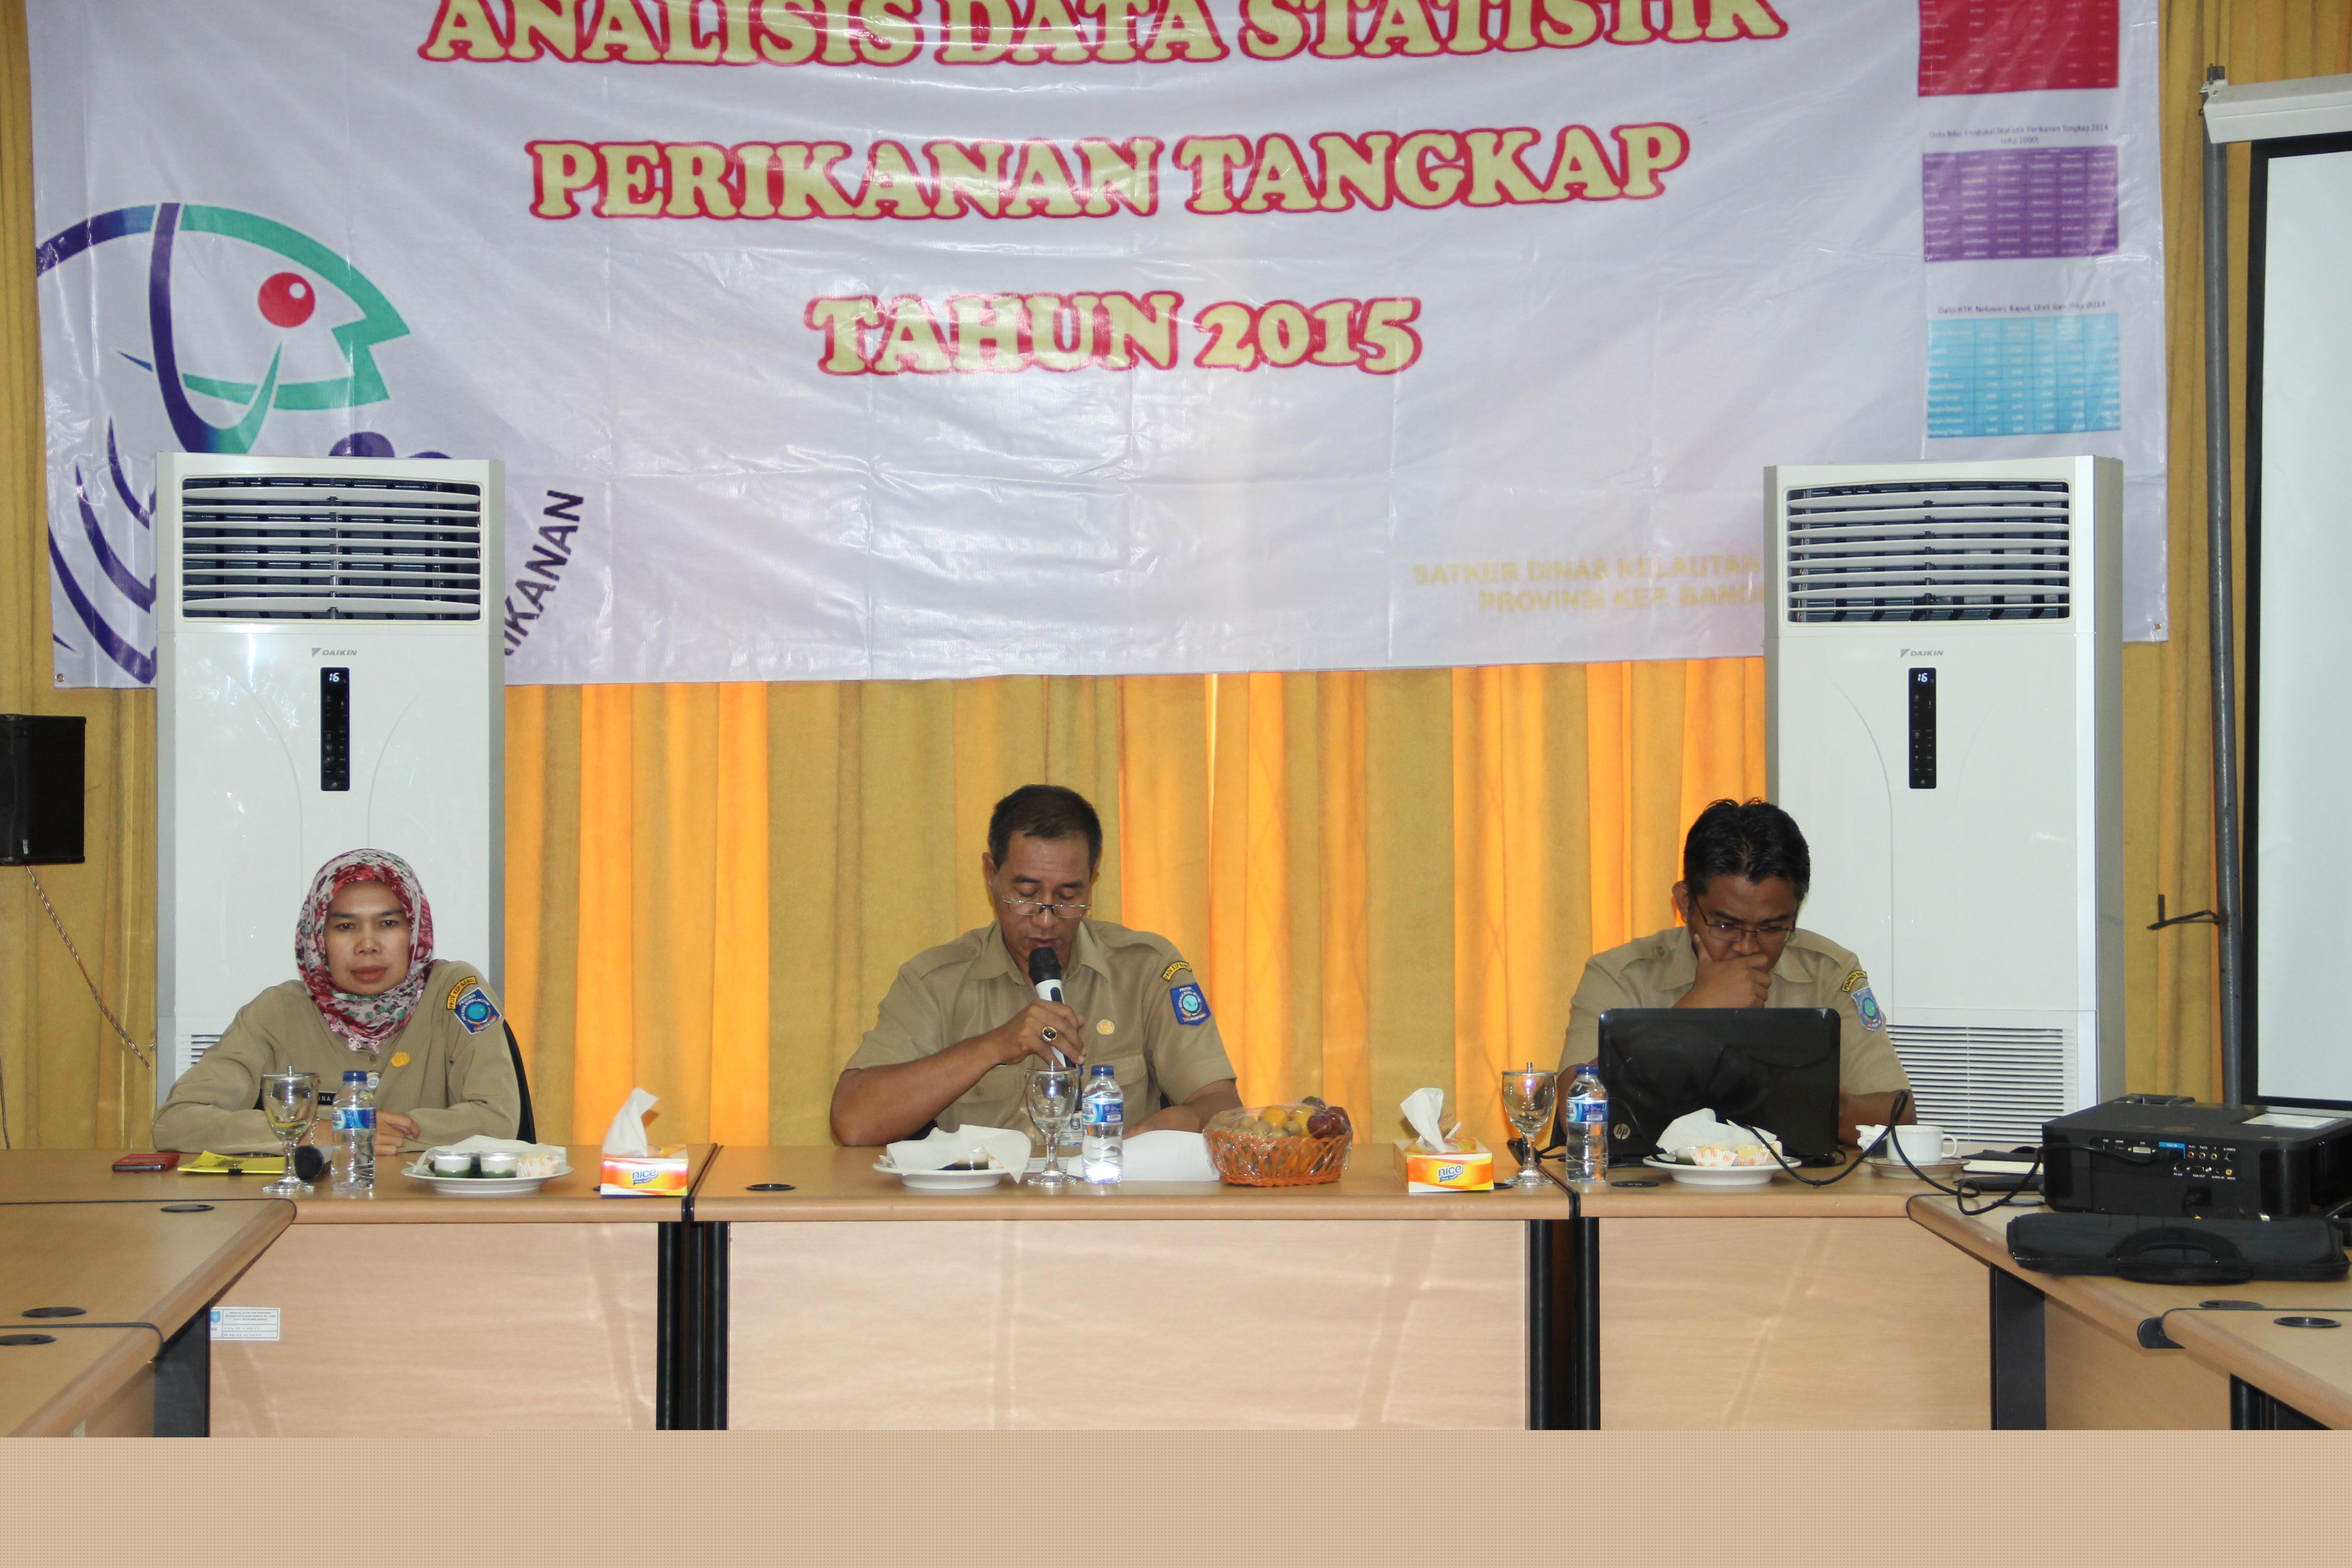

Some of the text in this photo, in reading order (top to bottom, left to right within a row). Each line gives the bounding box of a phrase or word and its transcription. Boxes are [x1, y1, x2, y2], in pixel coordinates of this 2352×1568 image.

[418, 0, 923, 67] ANALISIS
[933, 0, 1230, 64] DATA
[524, 122, 1689, 220] PERIKANAN TANGKAP
[803, 291, 1422, 377] TAHUN 2015
[505, 490, 584, 656] IKANAN
[1412, 554, 1760, 585] SATKER DINAS KELAUTAN
[1480, 589, 1605, 613] PROVINSI
[329, 673, 339, 682] 16
[1917, 673, 1928, 682] 16
[1617, 1123, 1628, 1139] hp
[632, 1169, 657, 1179] nice
[1438, 1165, 1462, 1176] nice
